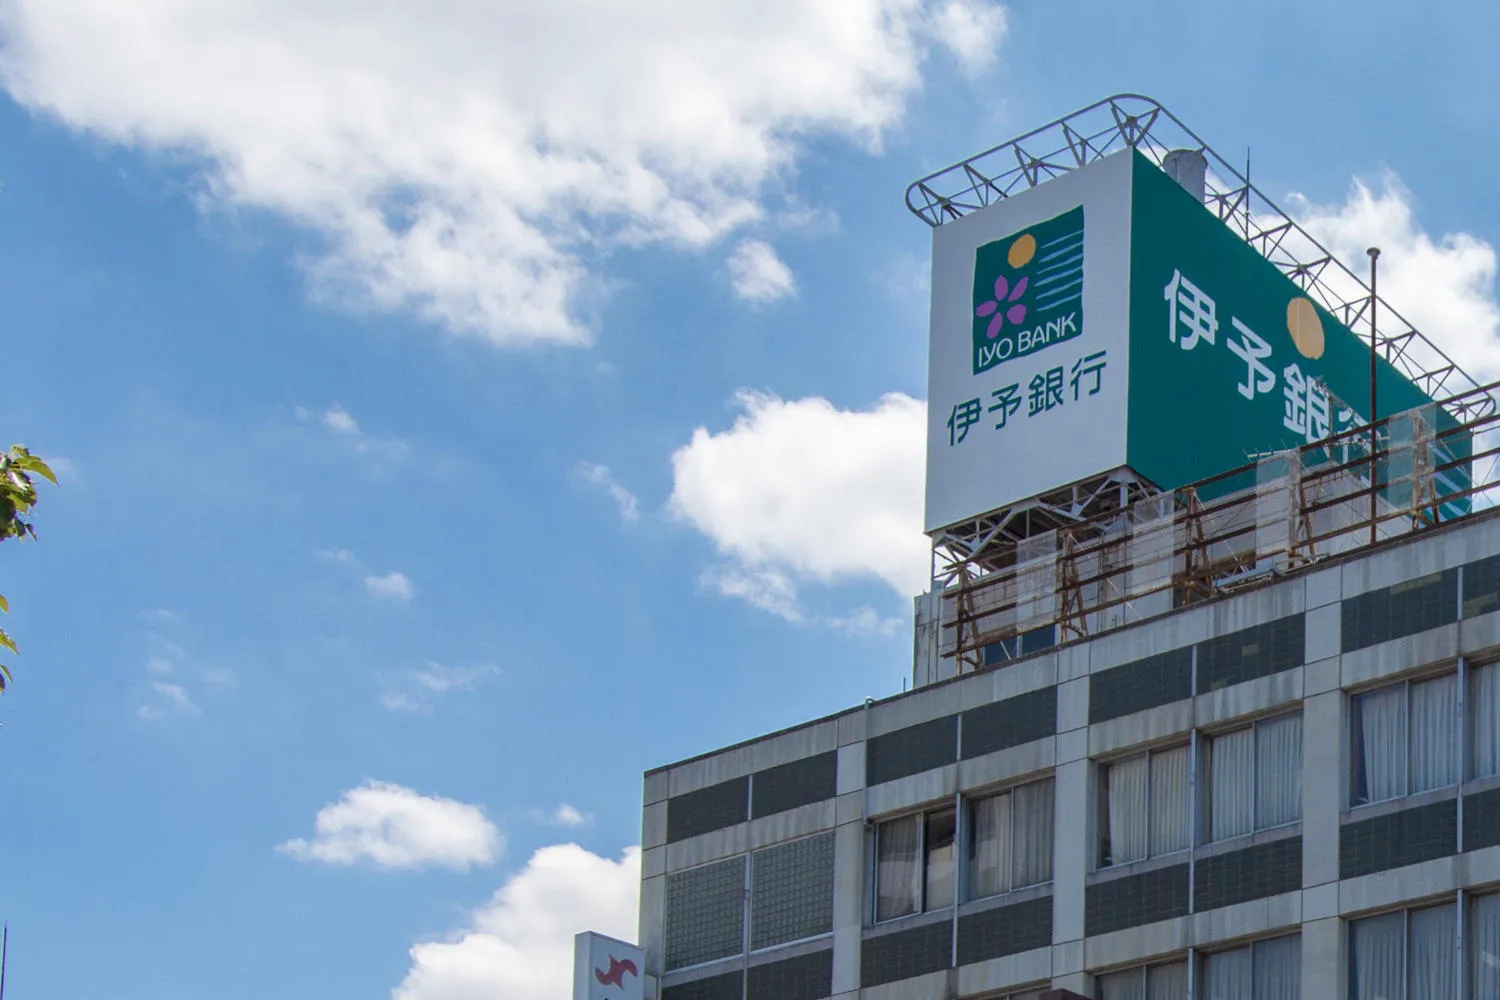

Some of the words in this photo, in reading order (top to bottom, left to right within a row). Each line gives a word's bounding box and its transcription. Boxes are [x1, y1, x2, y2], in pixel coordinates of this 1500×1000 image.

[978, 337, 1013, 368] IYO
[1017, 311, 1077, 353] BANK
[947, 349, 1107, 447] 伊予銀行
